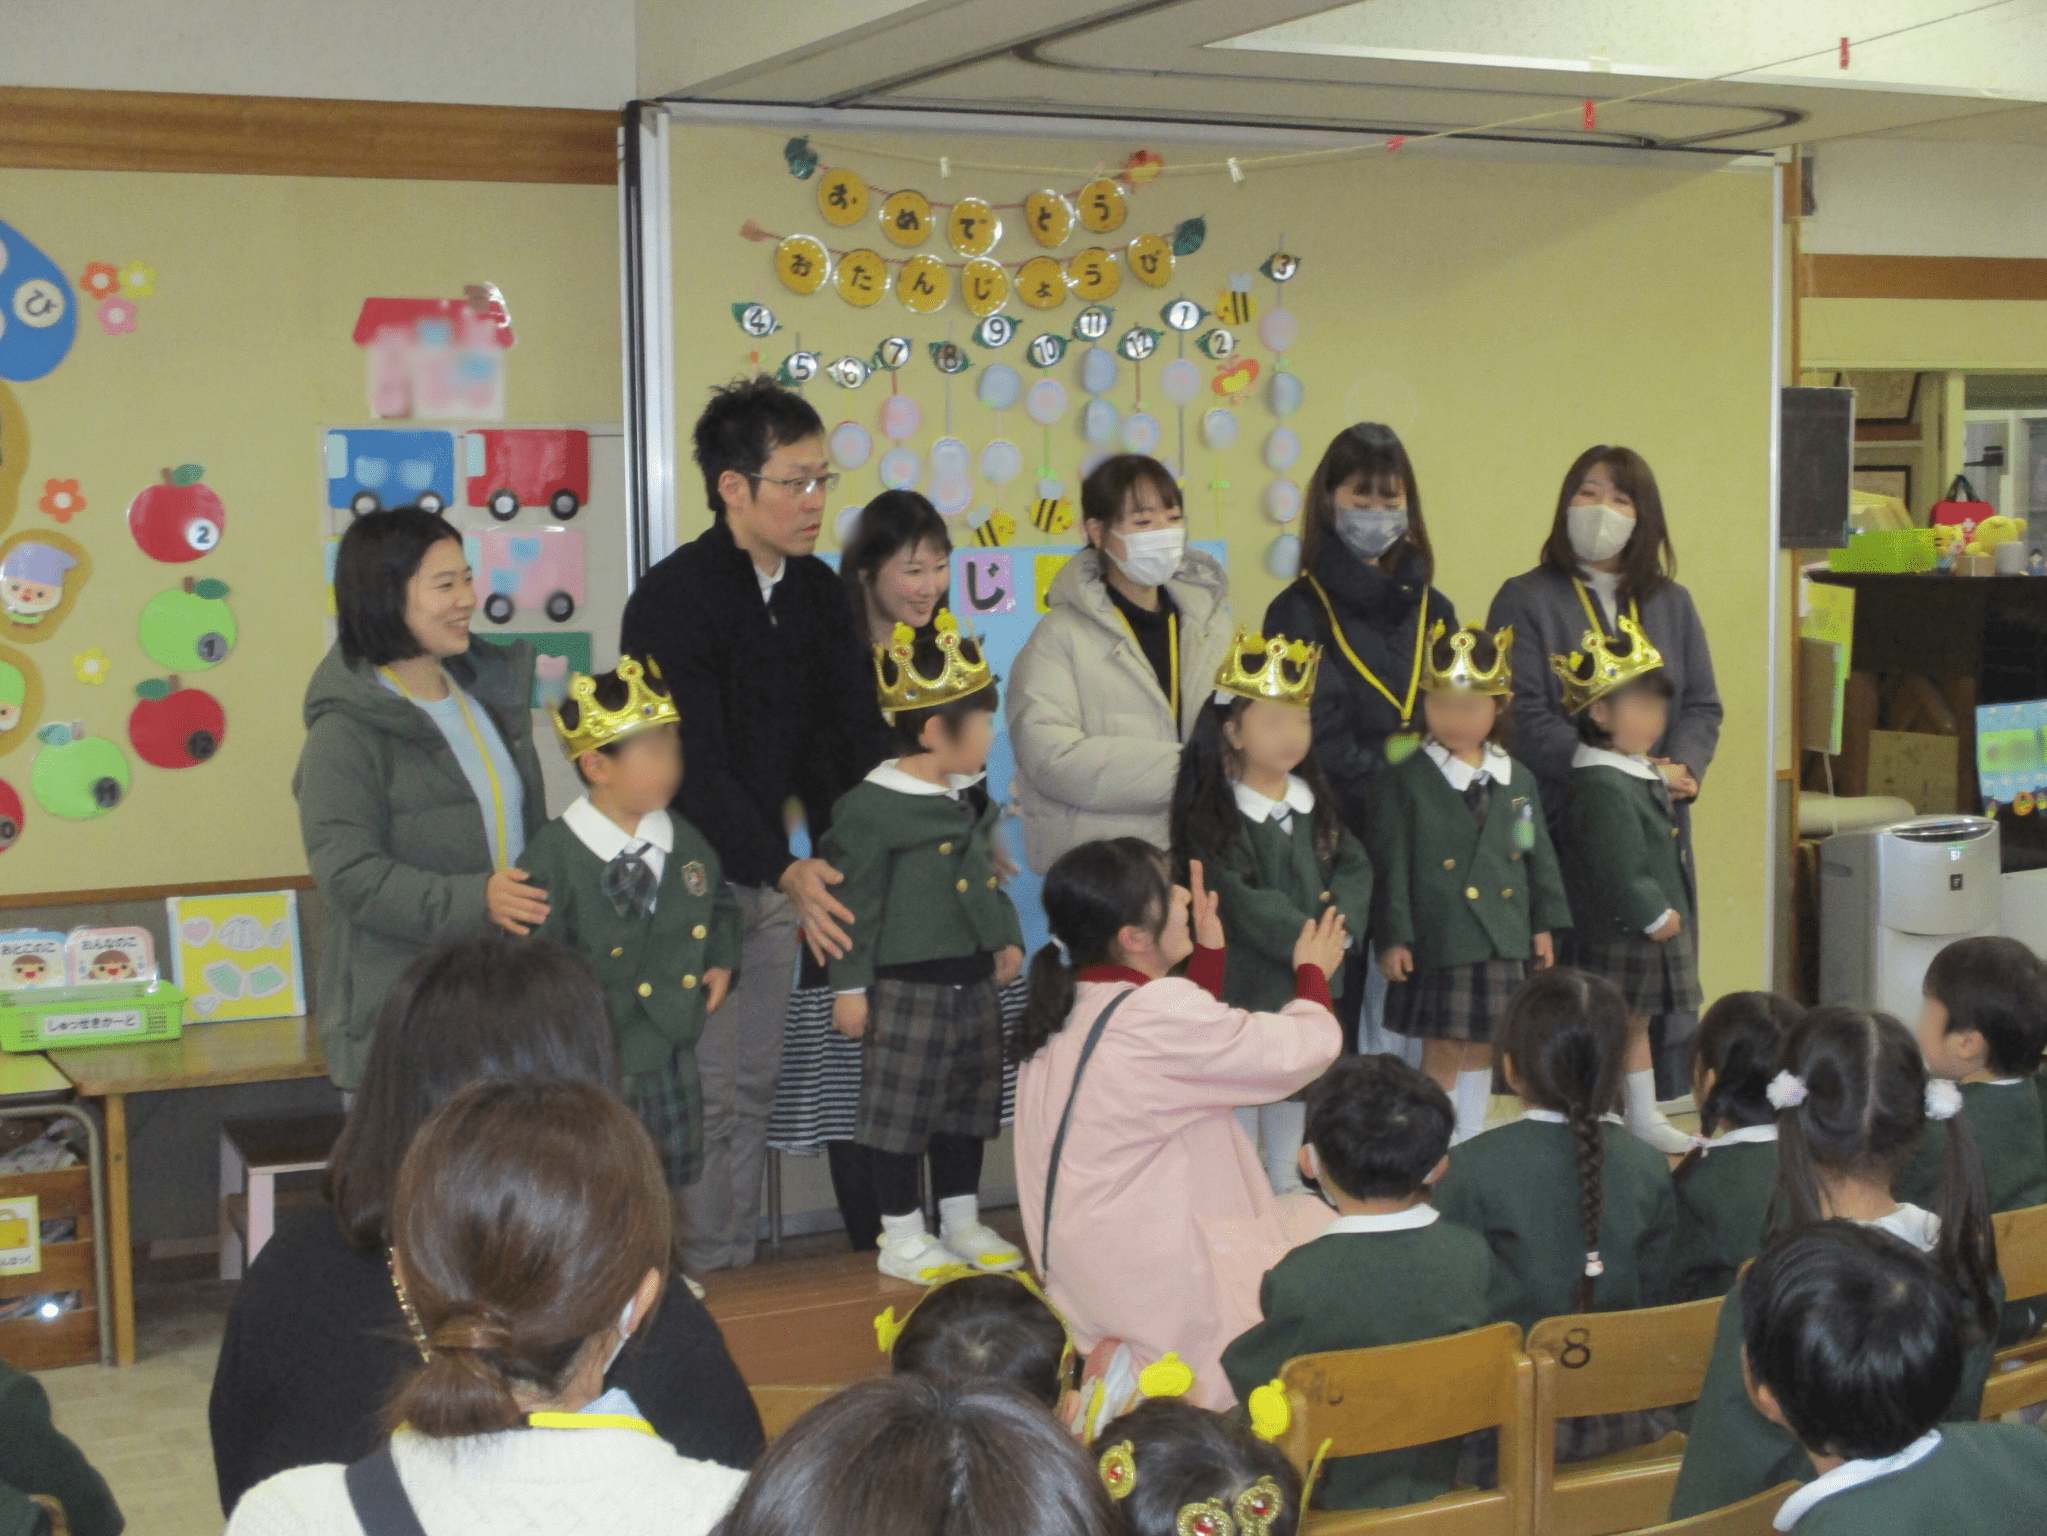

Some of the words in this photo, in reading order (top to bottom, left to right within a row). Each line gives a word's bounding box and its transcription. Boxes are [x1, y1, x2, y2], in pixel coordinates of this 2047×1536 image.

[828, 183, 1109, 239] おめでとう
[789, 249, 1161, 300] おたんじょうび
[1277, 254, 1291, 276] 3
[750, 308, 766, 333] 4
[989, 318, 1005, 344] 9
[1086, 312, 1101, 334] 11
[889, 340, 904, 365] 7
[943, 343, 958, 371] 8
[1034, 336, 1060, 365] 10
[1126, 330, 1151, 357] 12
[1214, 334, 1228, 355] 2
[796, 354, 810, 381] 5
[844, 358, 858, 385] 6
[197, 525, 211, 545] 2
[965, 560, 1006, 612] じ
[203, 638, 216, 658] 1
[1560, 1328, 1591, 1369] 8
